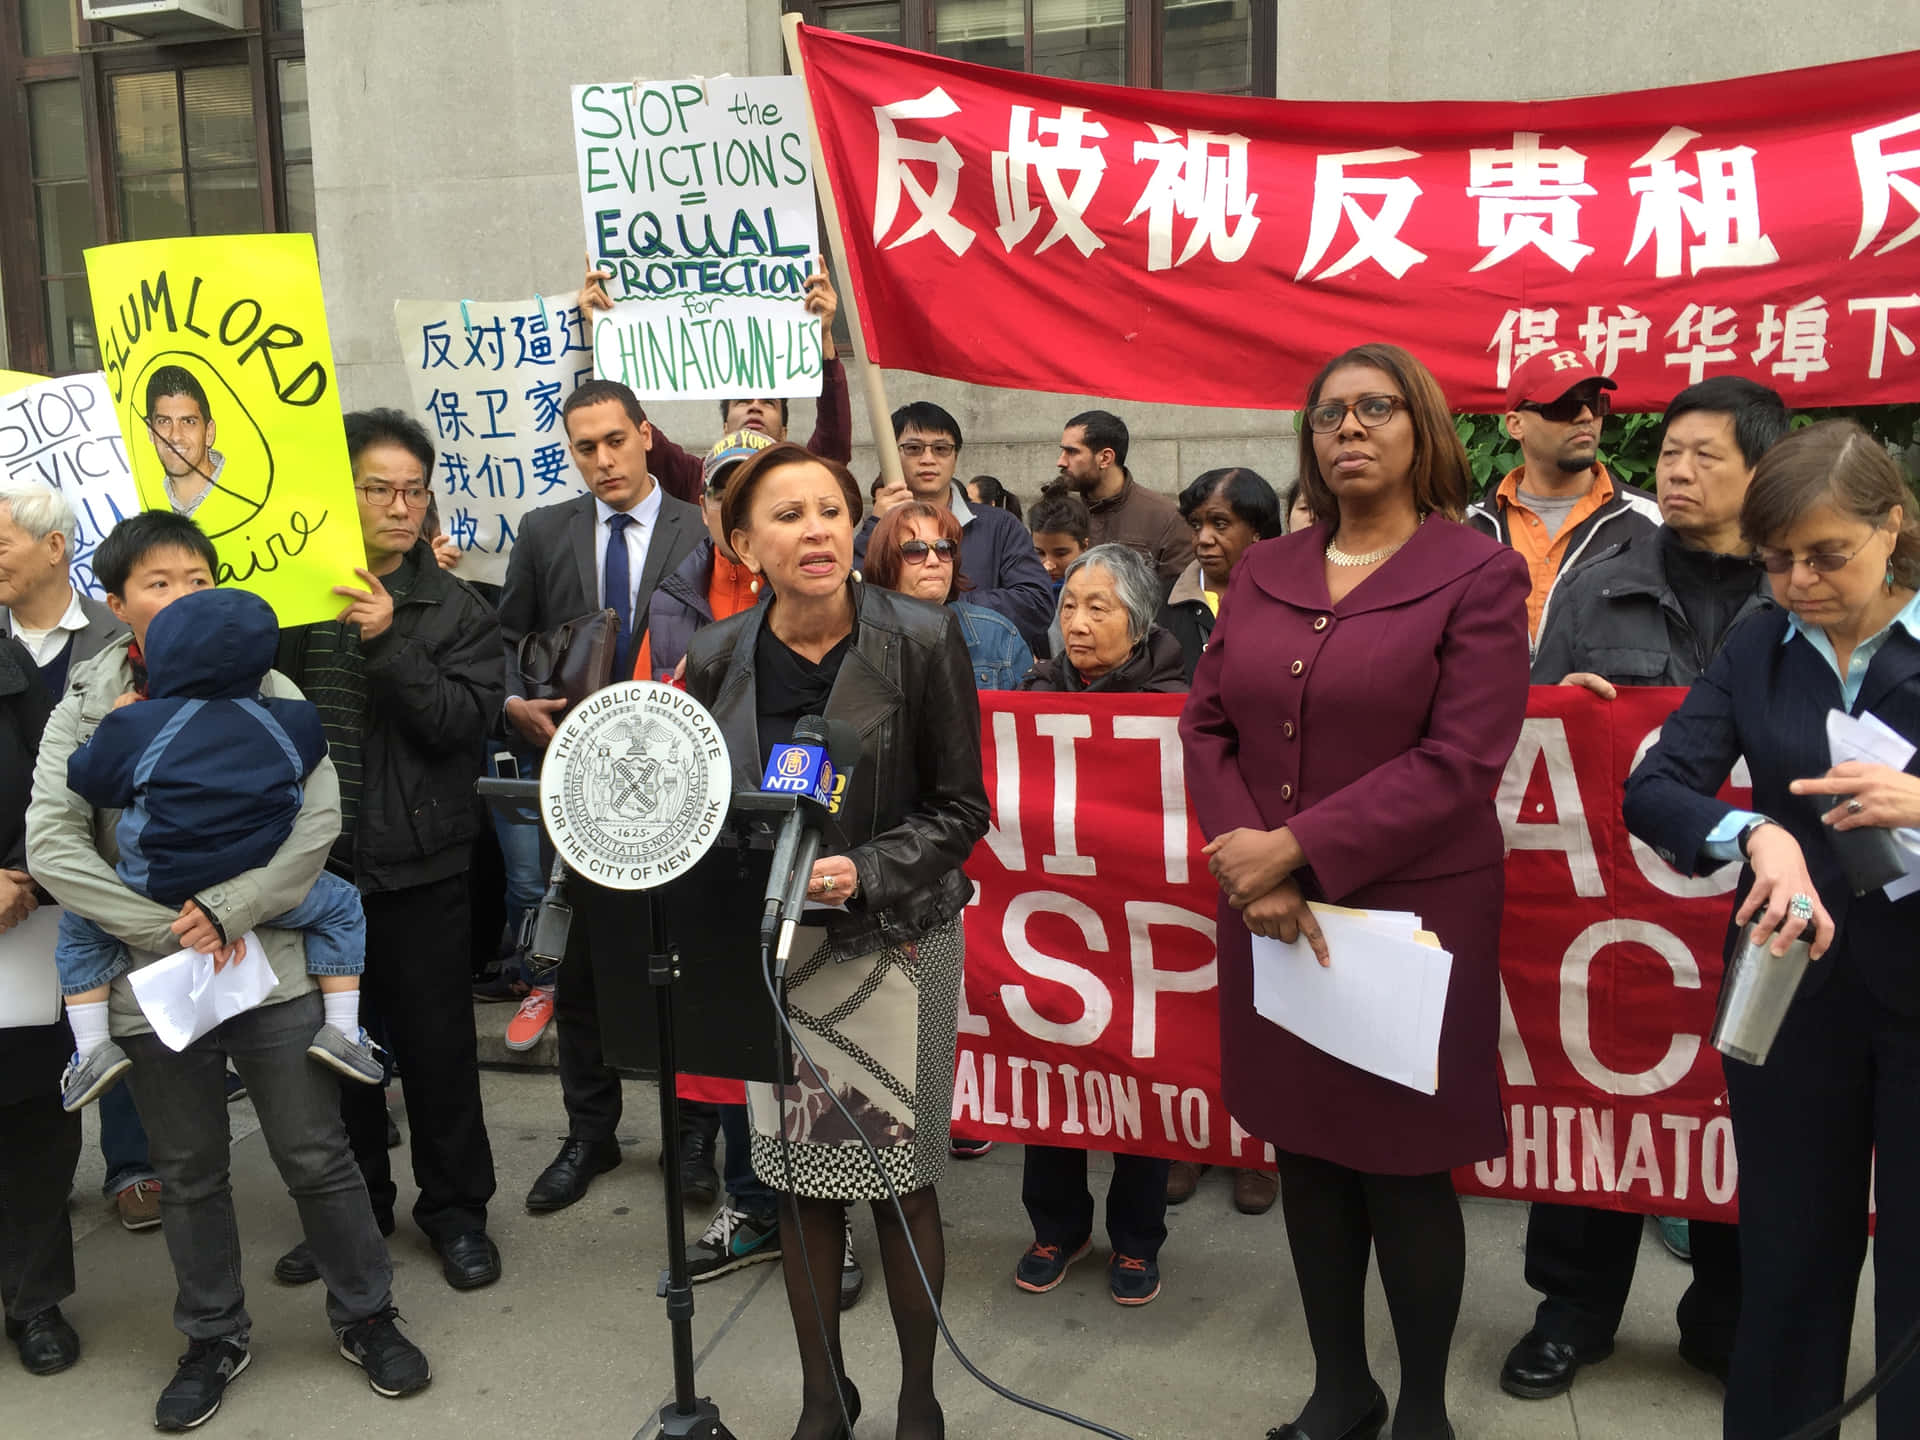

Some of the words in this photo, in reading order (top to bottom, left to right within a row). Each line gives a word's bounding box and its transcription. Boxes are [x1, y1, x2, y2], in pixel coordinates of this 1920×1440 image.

[581, 84, 703, 139] STOP
[728, 93, 782, 125] the
[587, 132, 806, 193] EVICTIONS
[595, 207, 810, 259] EQUAL
[596, 259, 812, 296] PROTECTION
[681, 295, 725, 317] for
[595, 315, 823, 391] CHINATOWN-LES
[1548, 351, 1583, 372] R
[555, 724, 580, 760] THE
[579, 688, 641, 723] PUBLIC
[648, 689, 722, 760] ADVOCATE
[767, 776, 808, 791] NTD
[549, 794, 567, 831] FOR
[562, 832, 588, 863] THE
[589, 859, 625, 879] CITY
[630, 868, 652, 880] OF
[657, 846, 691, 875] NEW
[691, 799, 721, 847] YORK
[1152, 1084, 1210, 1149] TO
